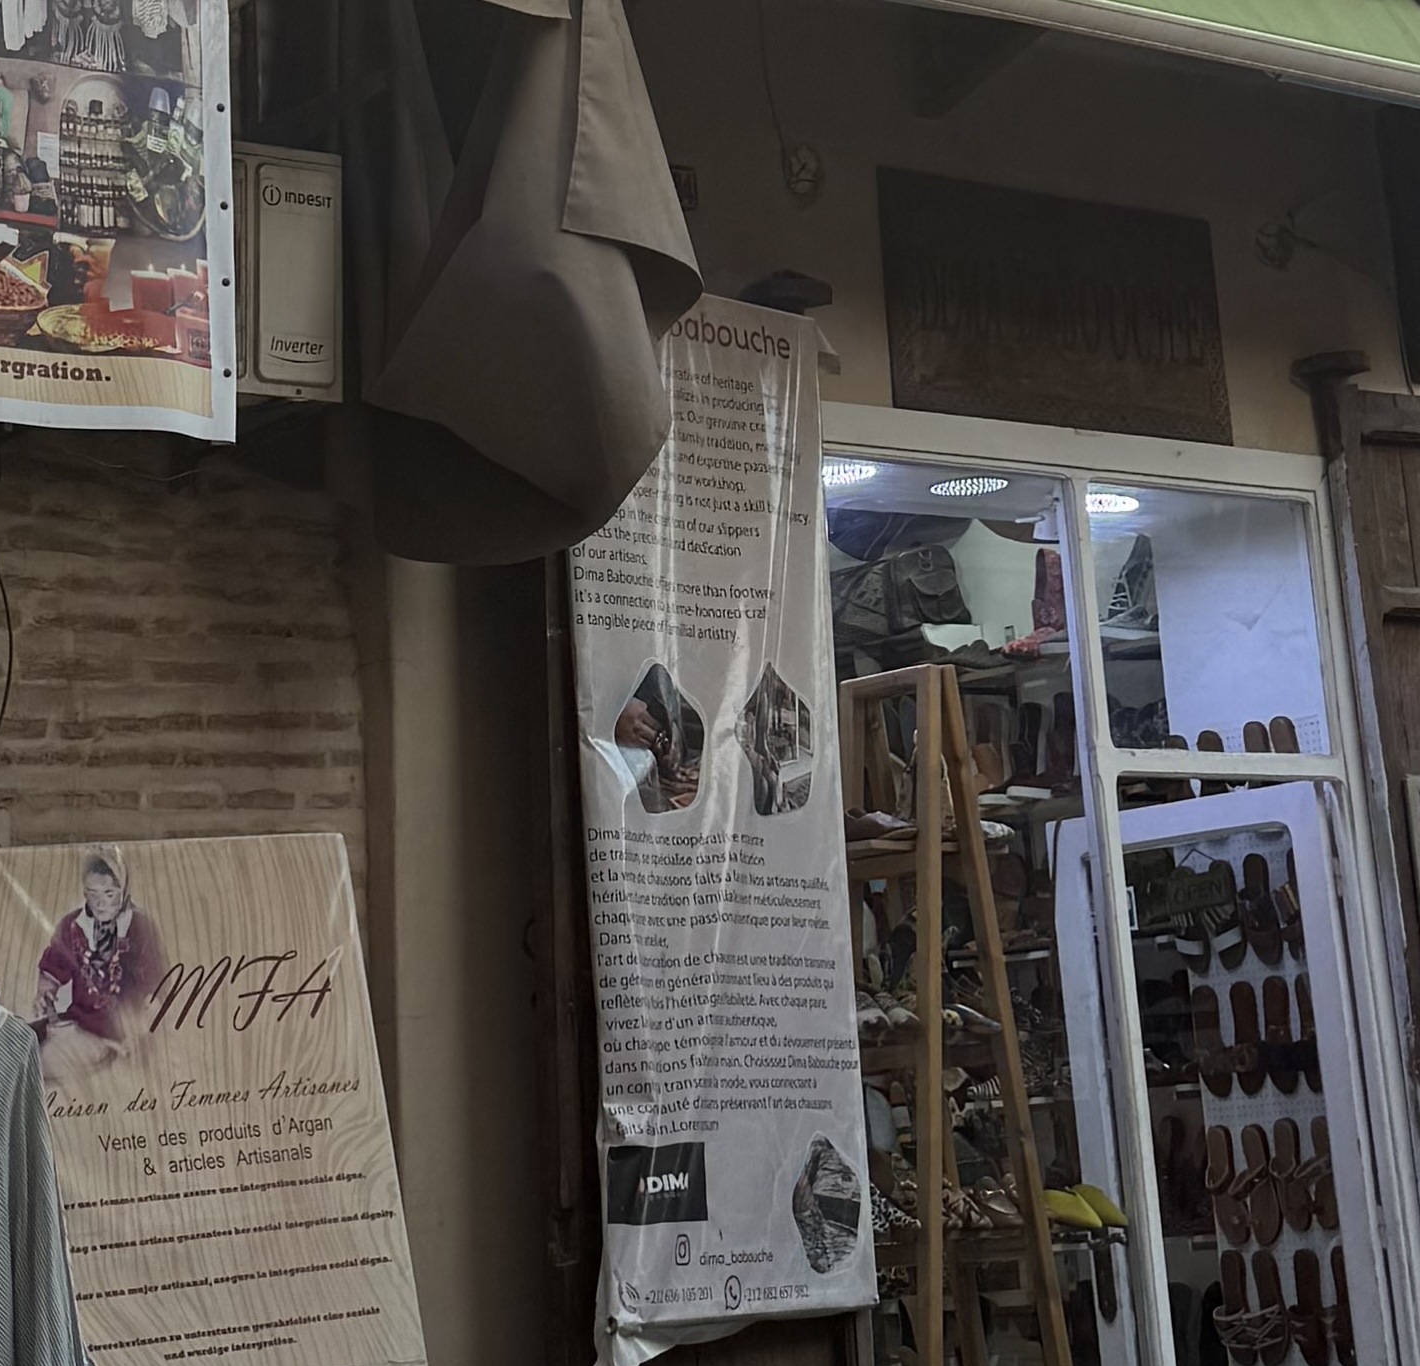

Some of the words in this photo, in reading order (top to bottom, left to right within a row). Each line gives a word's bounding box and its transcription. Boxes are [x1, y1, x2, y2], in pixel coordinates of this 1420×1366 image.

[269, 336, 324, 359] Inverter
[600, 932, 631, 946] Dans
[124, 1088, 156, 1112] des
[170, 1079, 249, 1111] Femmes
[257, 1070, 360, 1100] Artisanes
[98, 1128, 147, 1151] Vente
[158, 1125, 187, 1147] des
[199, 1119, 261, 1148] produits
[272, 1114, 333, 1137] d'Argan
[143, 1157, 157, 1176] &
[169, 1153, 225, 1173] articles
[236, 1143, 313, 1167] Artisanals
